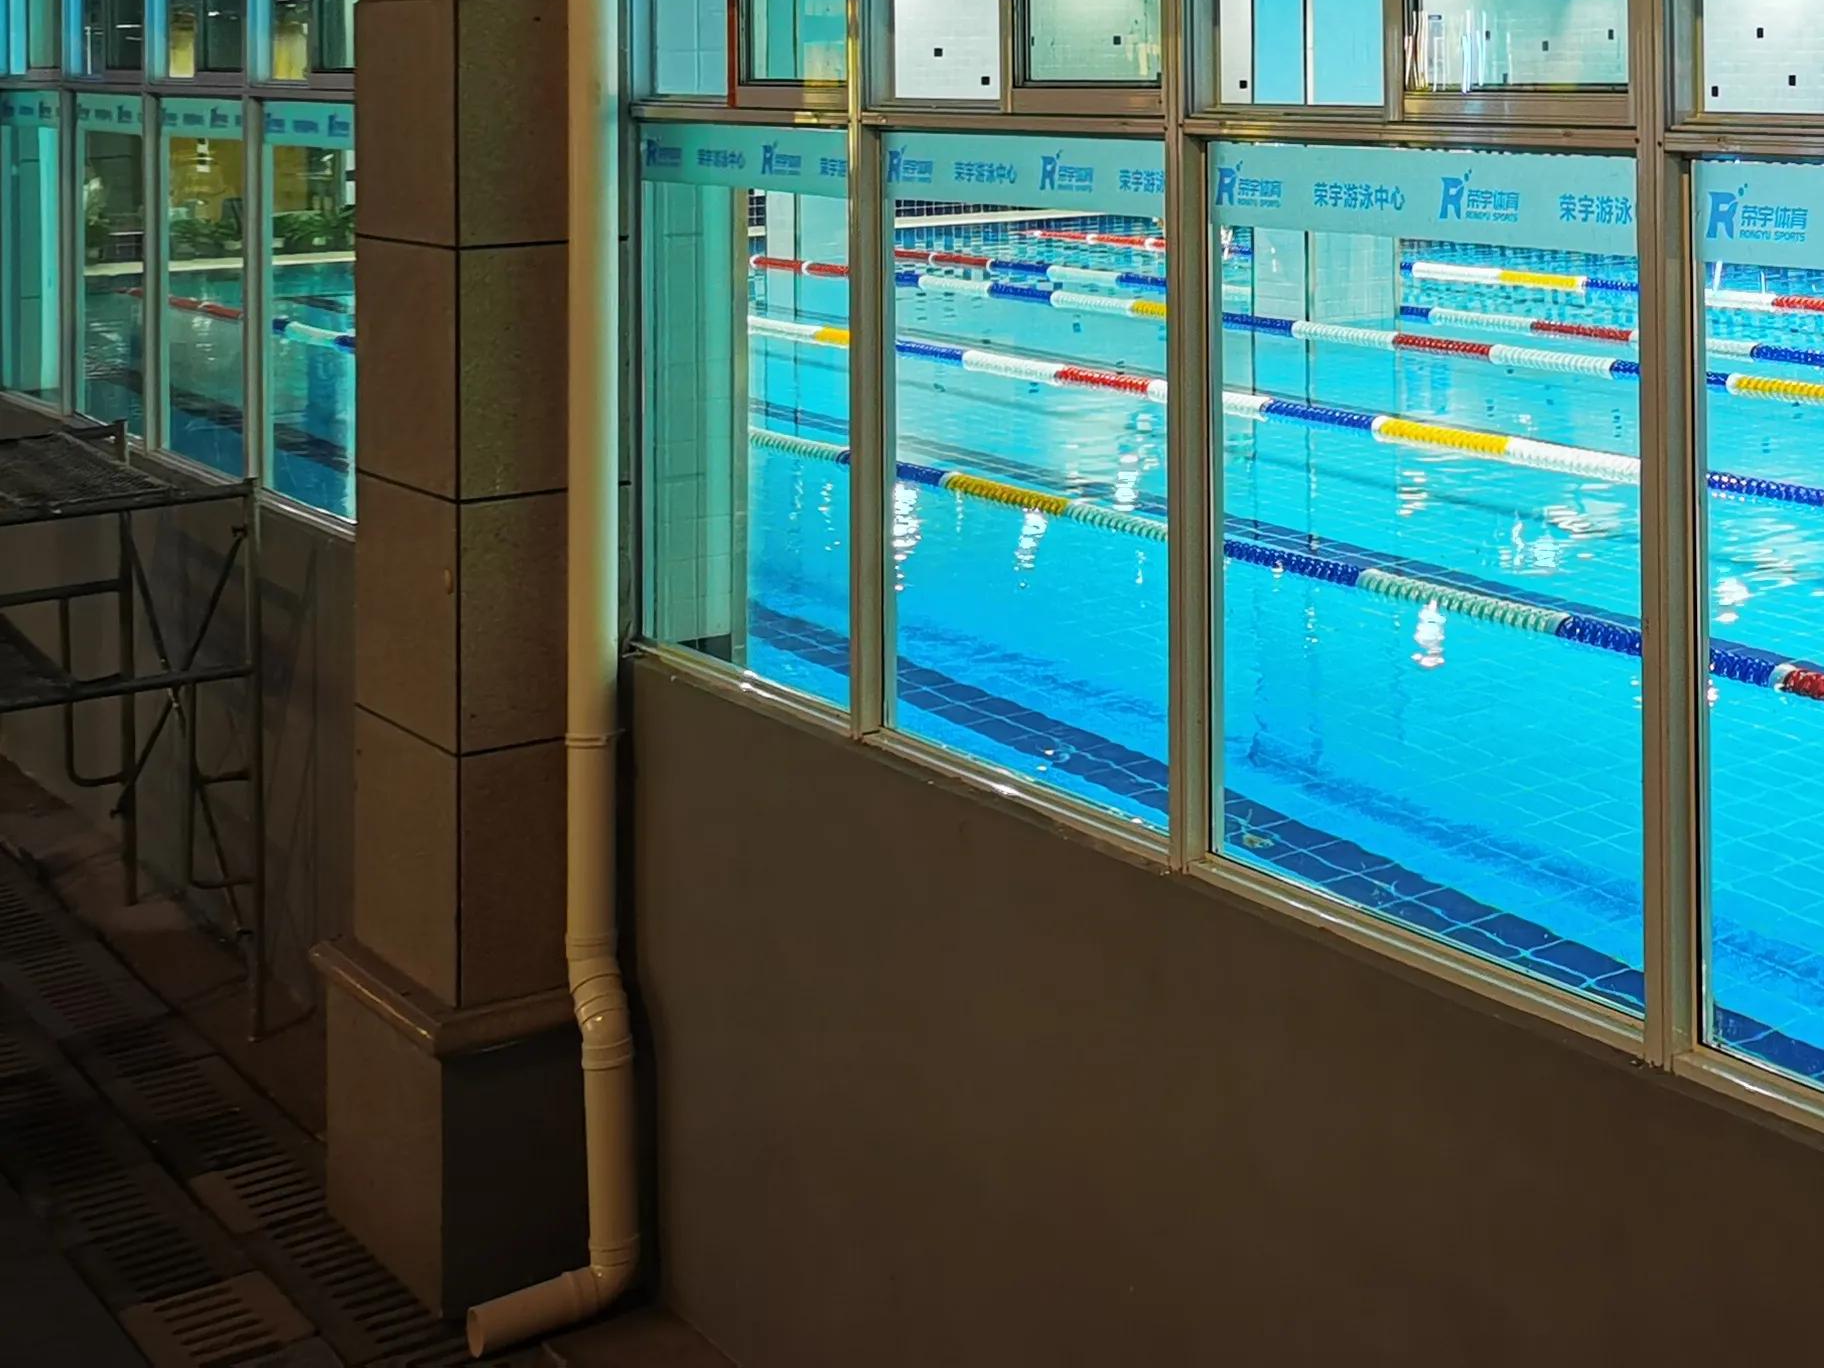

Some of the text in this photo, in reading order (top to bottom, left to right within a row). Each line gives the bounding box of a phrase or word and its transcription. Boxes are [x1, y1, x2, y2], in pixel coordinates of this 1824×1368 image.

[1314, 182, 1406, 210] 荣宇游泳中心
[1741, 205, 1808, 230] 荣宇体育
[1739, 229, 1805, 242] RONGYU SPORTS
